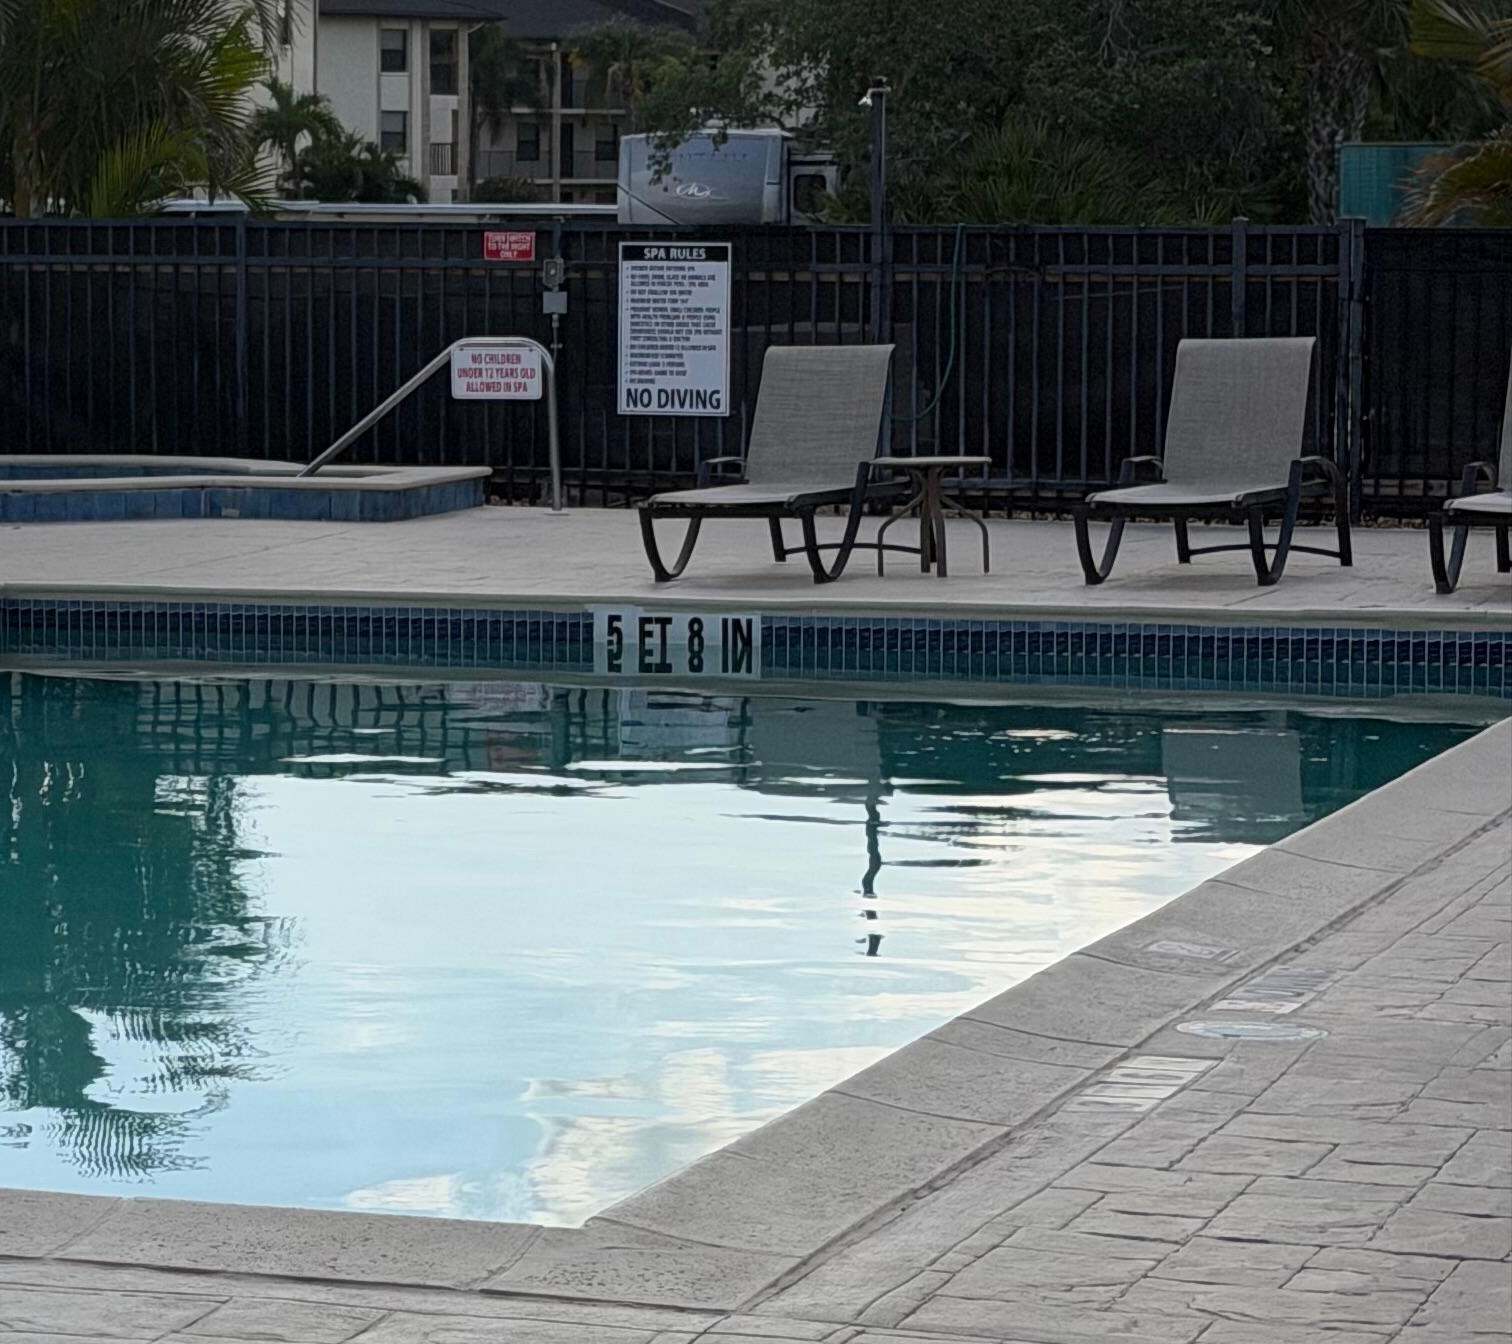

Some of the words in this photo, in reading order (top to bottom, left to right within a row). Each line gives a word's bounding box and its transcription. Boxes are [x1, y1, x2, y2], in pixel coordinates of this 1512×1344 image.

[643, 247, 666, 260] SPA
[669, 247, 706, 260] RULES
[471, 353, 482, 364] NO
[484, 353, 521, 365] CHILDREN
[457, 367, 483, 379] UNDER
[485, 367, 494, 379] 12
[495, 367, 519, 379] YEARS
[520, 367, 536, 380] OLD
[466, 381, 502, 393] ALLOWED
[503, 381, 512, 393] IN
[513, 381, 528, 393] SPA
[626, 387, 652, 409] NO
[657, 388, 721, 410] DIVING
